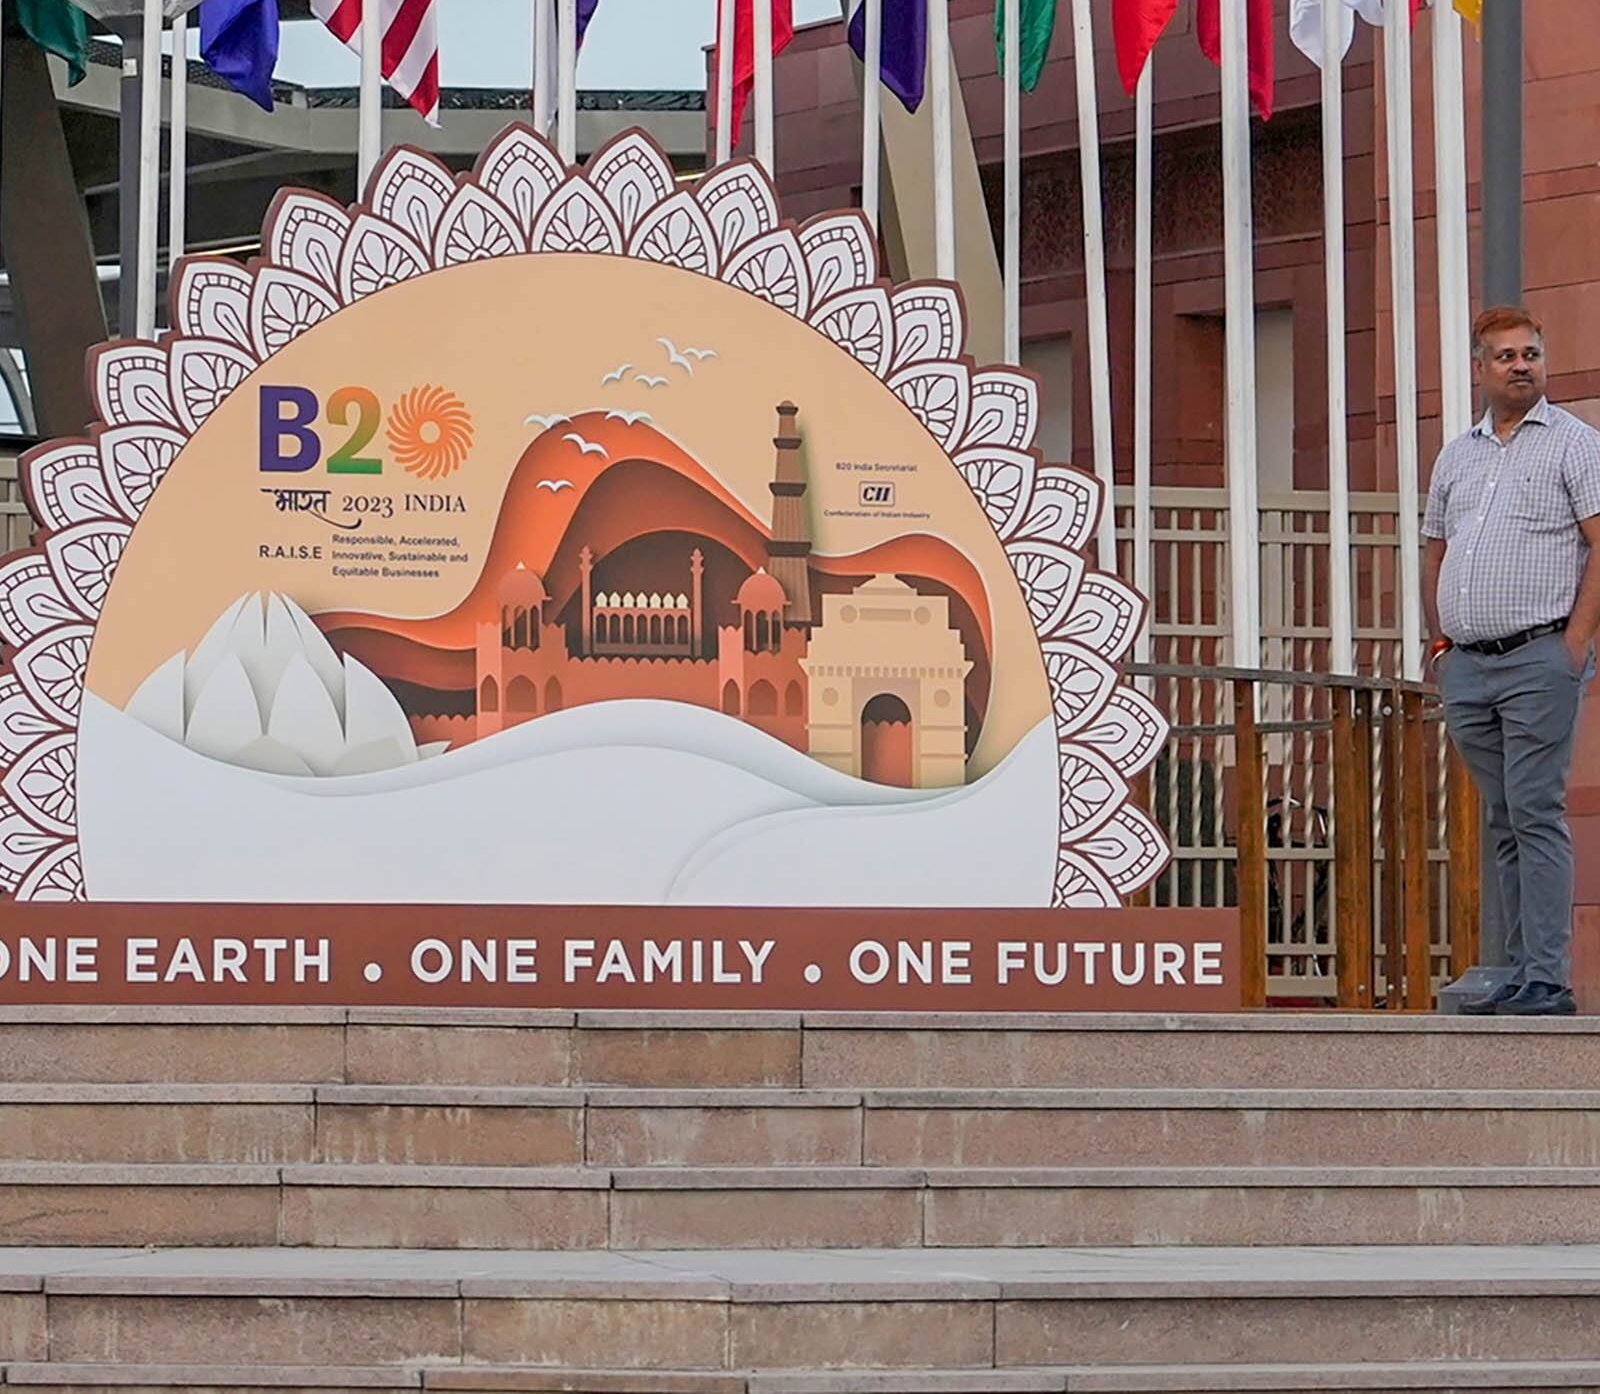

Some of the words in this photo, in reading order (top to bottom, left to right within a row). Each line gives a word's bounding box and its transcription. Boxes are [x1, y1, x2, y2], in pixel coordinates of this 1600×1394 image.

[863, 486, 891, 502] CII
[342, 495, 395, 519] 2023
[405, 493, 467, 513] INDIA
[332, 534, 397, 546] Responsible,
[399, 535, 461, 547] Accelerated,
[259, 544, 323, 560] R.A.I.S.E
[332, 550, 386, 562] Innovative,
[388, 551, 447, 563] Sustainable
[449, 552, 469, 563] and
[332, 566, 379, 579] Equitable
[381, 567, 440, 578] Businesses
[125, 937, 331, 984] EARTH
[409, 938, 538, 984] ONE
[565, 938, 777, 984] FAMILY
[848, 940, 972, 985] ONE
[997, 941, 1224, 986] FUTURE
